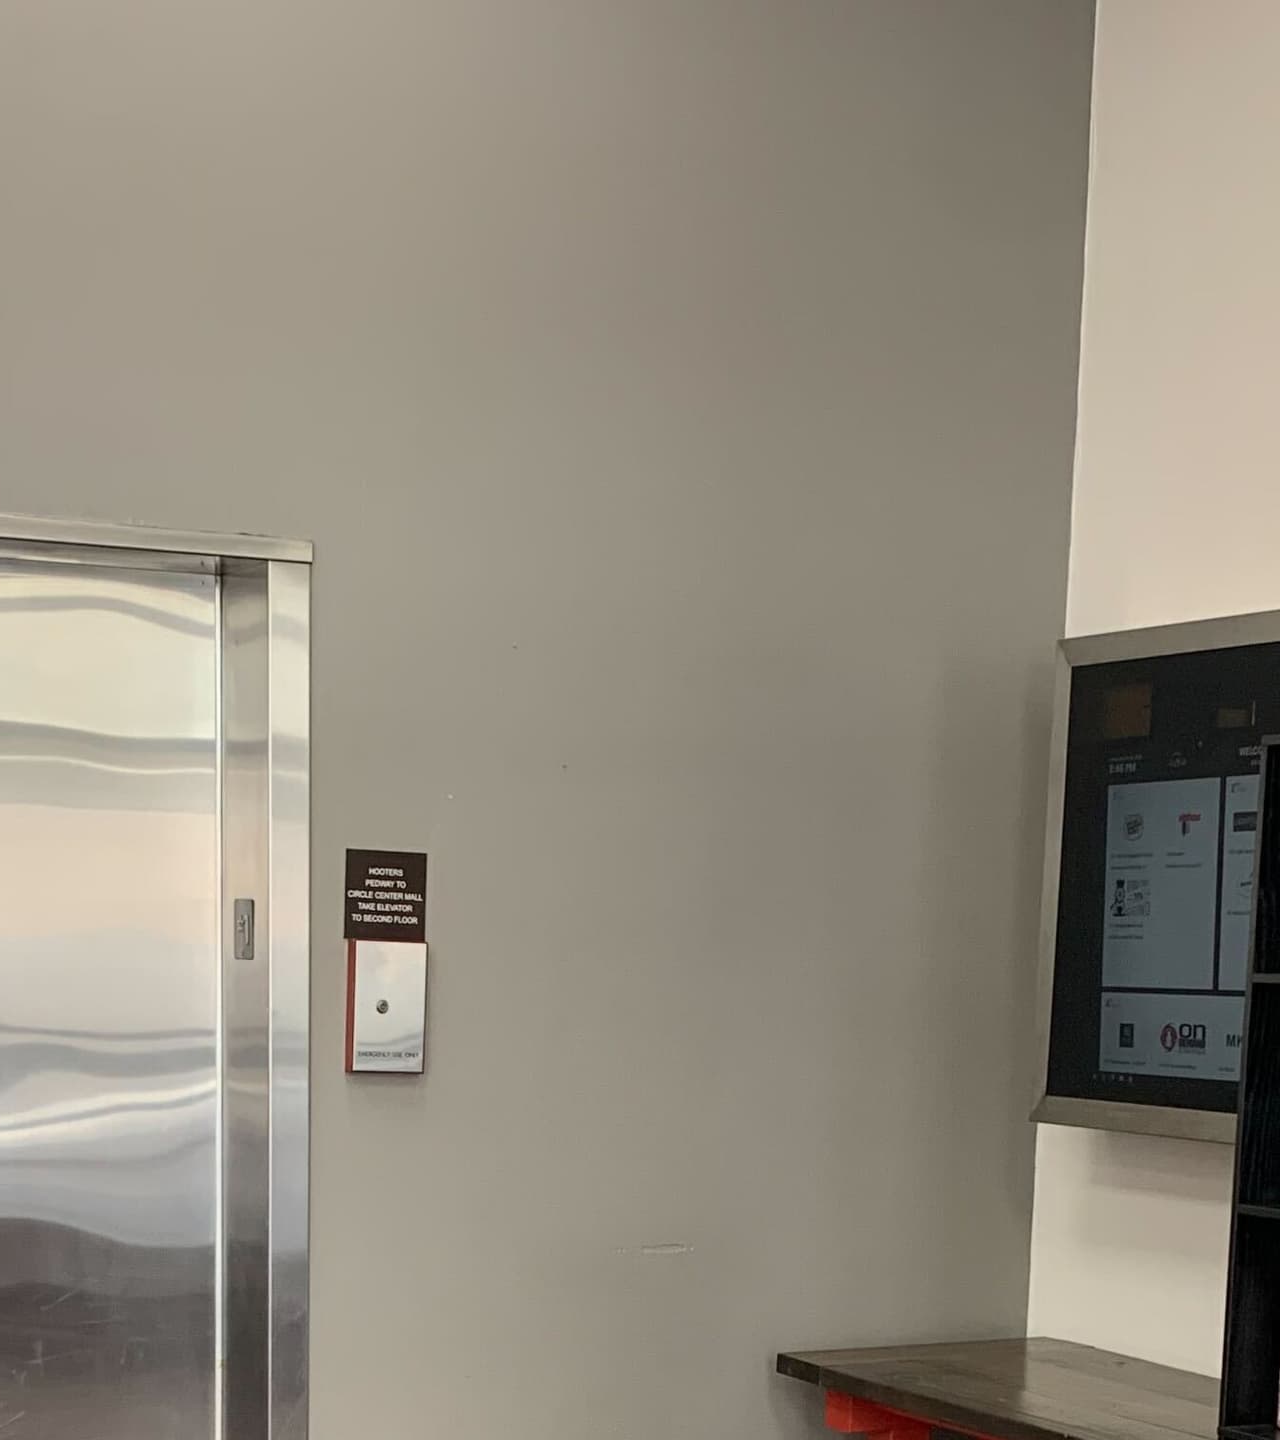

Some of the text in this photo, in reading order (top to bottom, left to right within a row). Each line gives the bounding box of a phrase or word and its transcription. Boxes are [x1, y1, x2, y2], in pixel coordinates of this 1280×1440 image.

[368, 867, 404, 877] HOOTERS
[396, 881, 407, 889] TO
[347, 890, 423, 901] CIRCLE CENTER MALL
[358, 902, 413, 912] TAKE ELEVATOR
[351, 913, 418, 924] TO SECOND FLOOR
[1179, 1023, 1206, 1041] on
